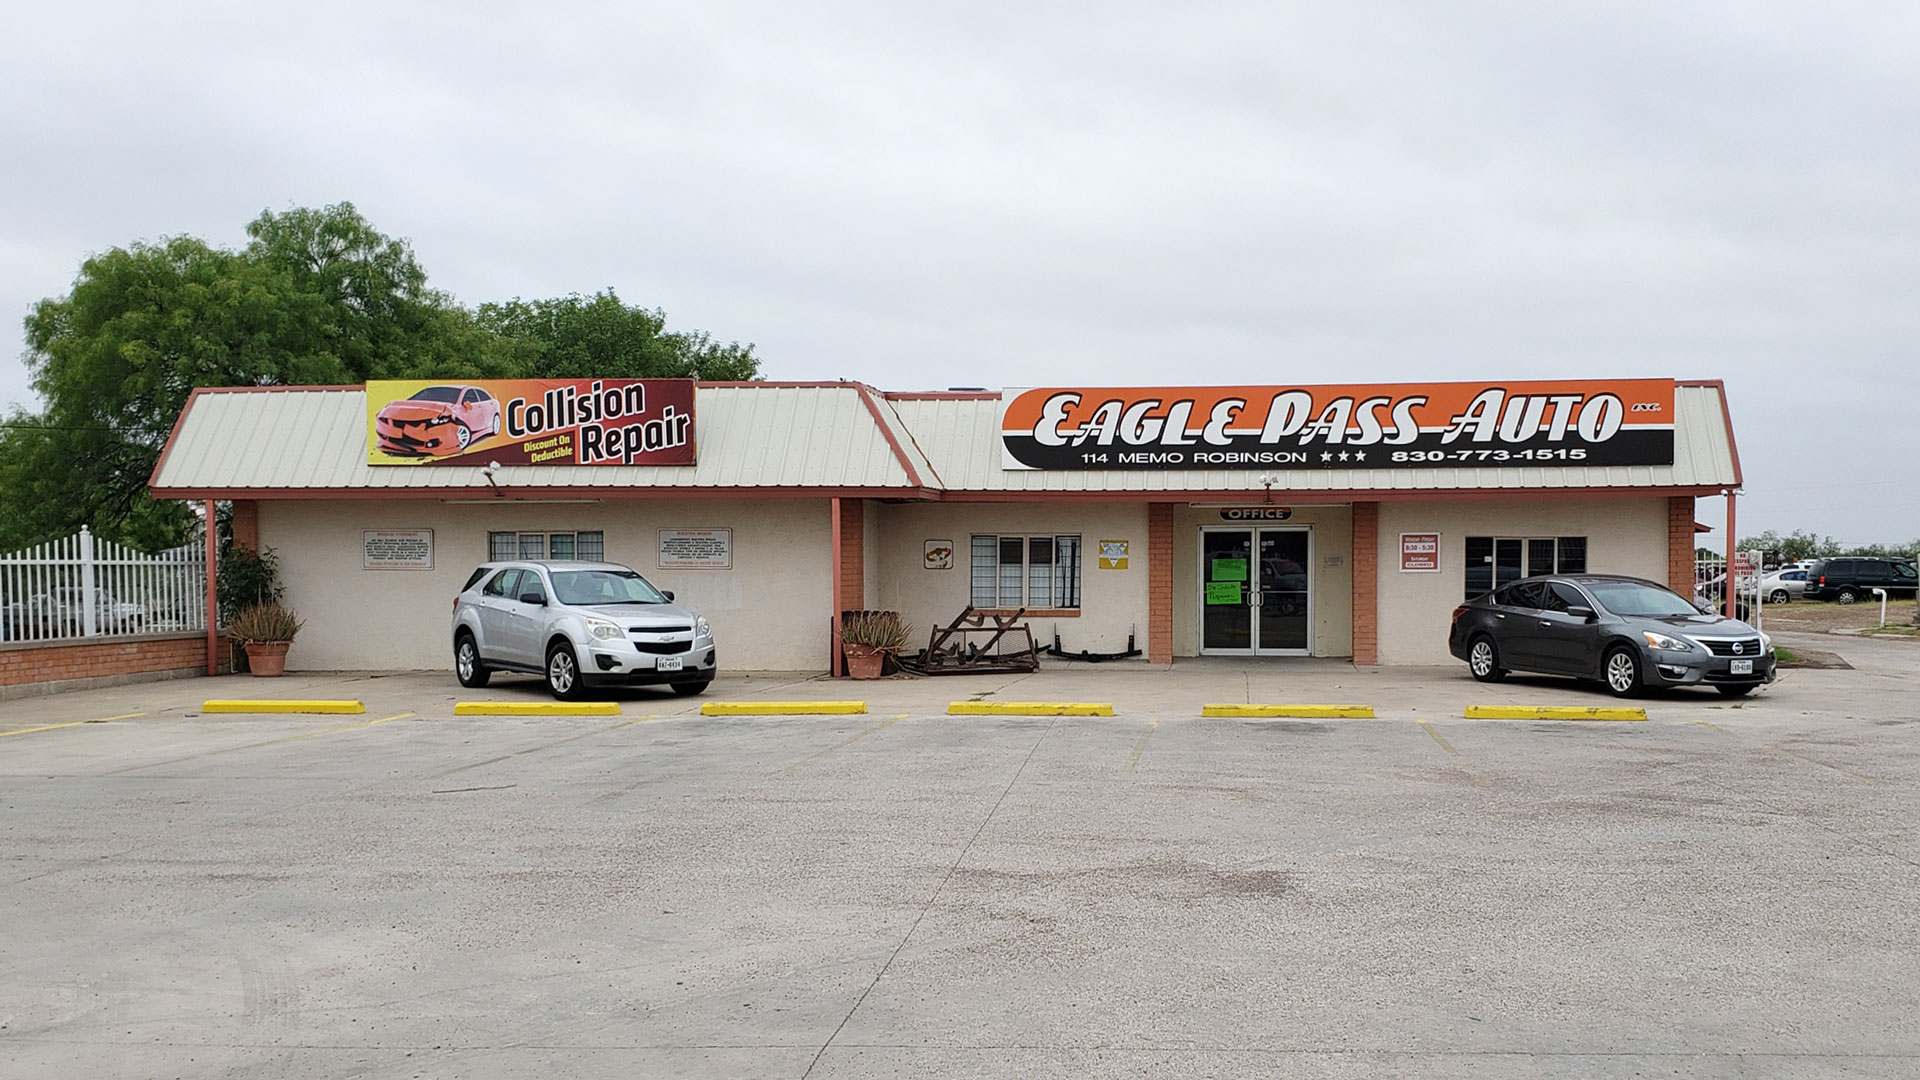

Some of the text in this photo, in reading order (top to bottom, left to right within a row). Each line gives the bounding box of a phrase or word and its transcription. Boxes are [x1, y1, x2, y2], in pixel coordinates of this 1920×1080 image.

[507, 381, 645, 437] Collision
[1034, 391, 1247, 447] EAGLE
[1260, 389, 1429, 446] PASS
[1441, 388, 1625, 444] AUTO
[524, 435, 571, 452] Discount On
[580, 406, 690, 464] Repair
[531, 446, 573, 463] Deductible
[1081, 449, 1587, 464] 114 MEMO ROBINSON 830-773-1515
[1228, 509, 1284, 519] OFFICE
